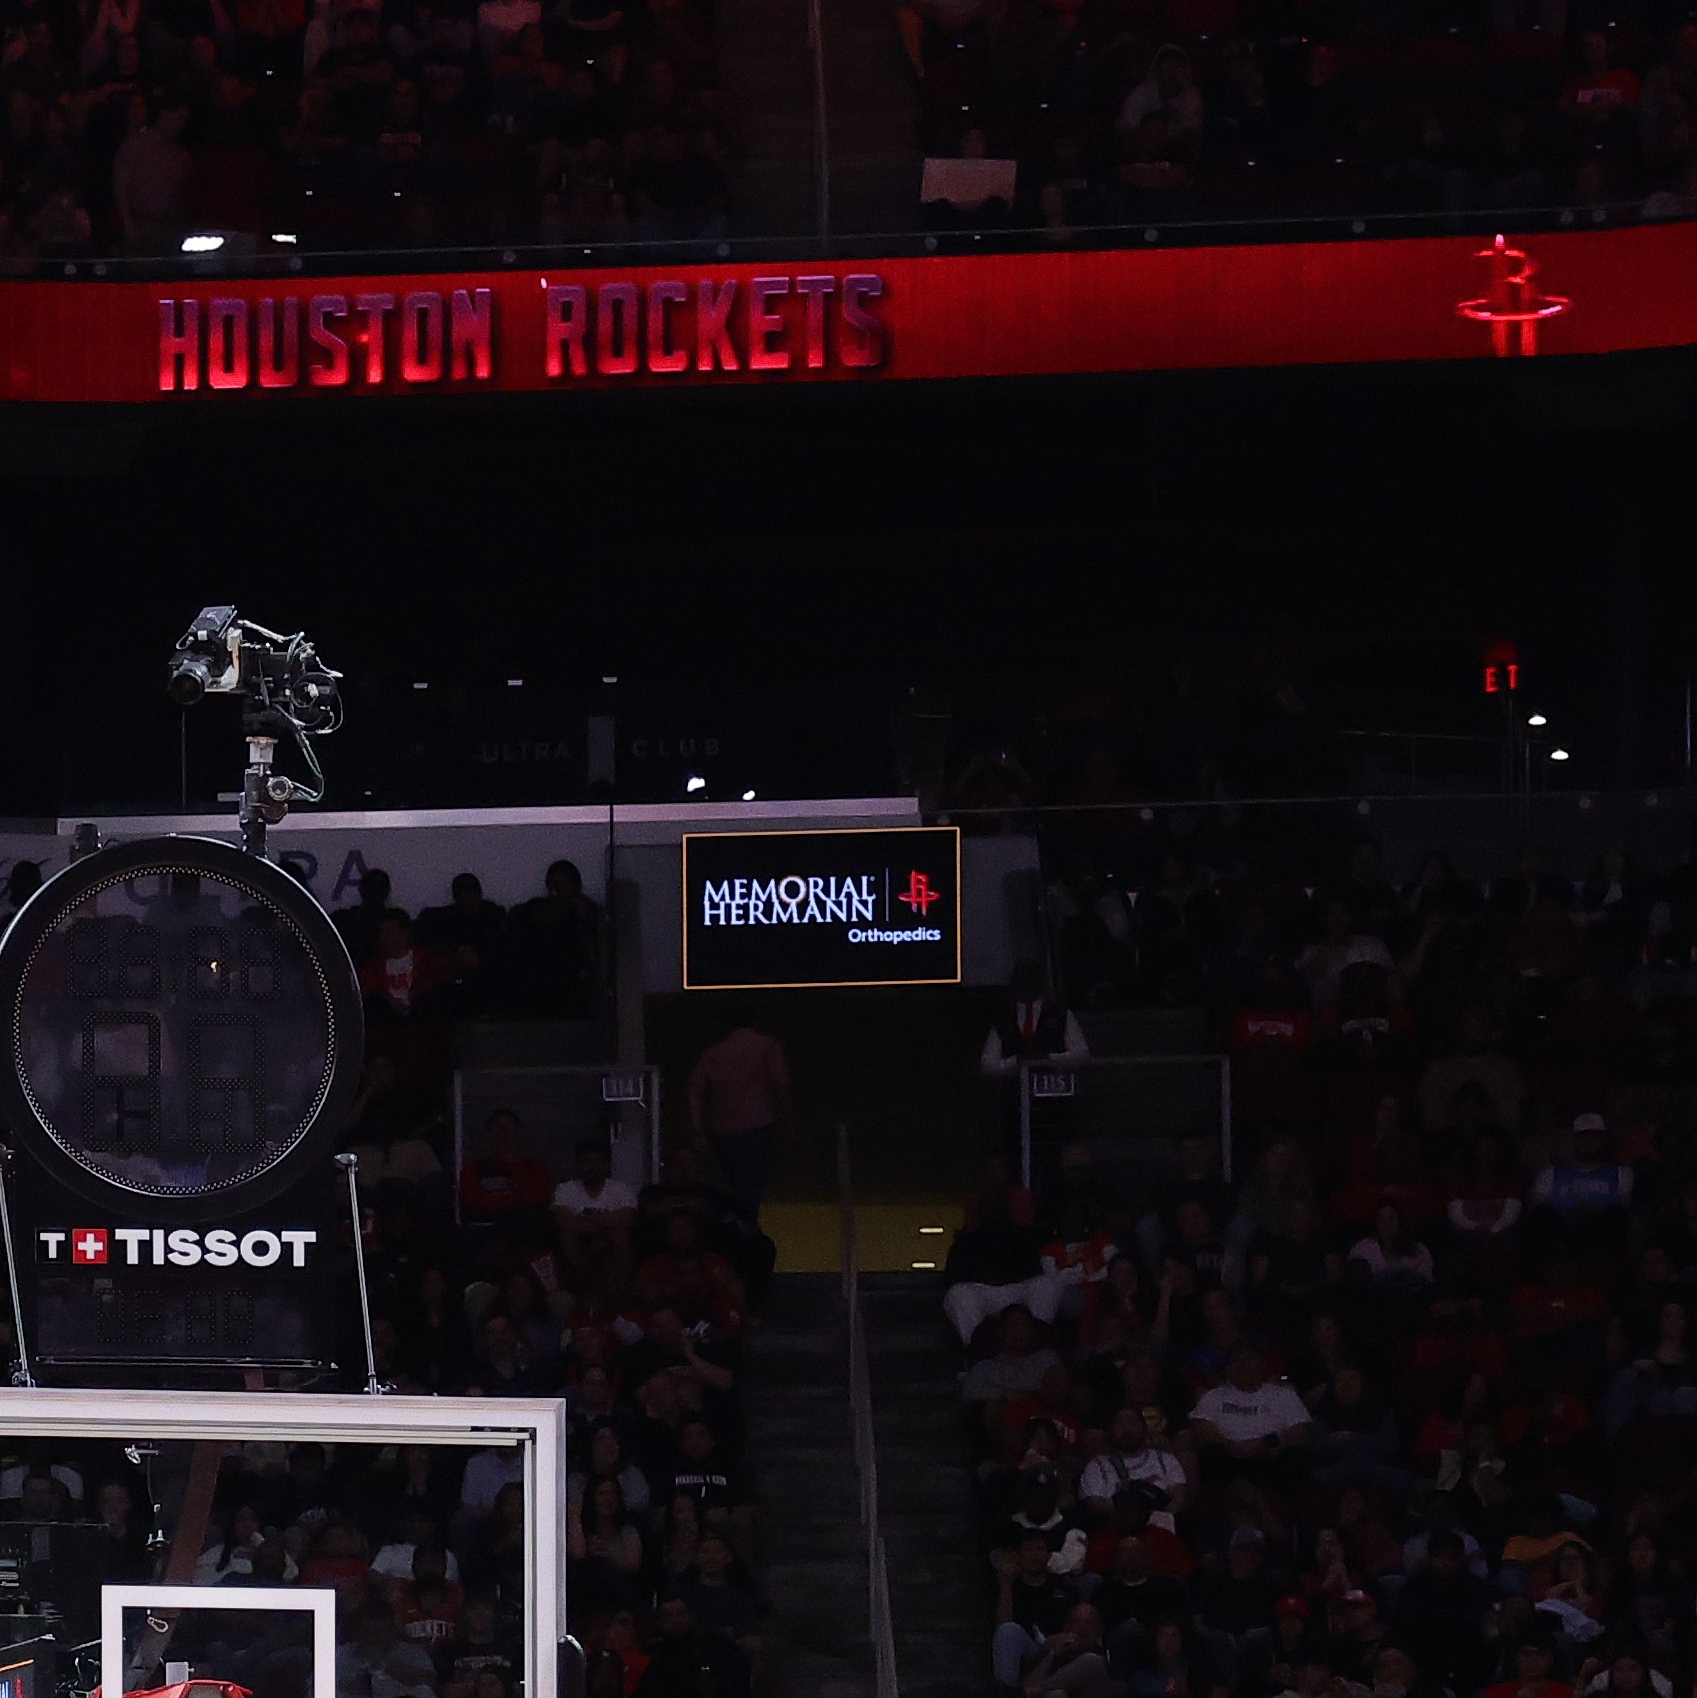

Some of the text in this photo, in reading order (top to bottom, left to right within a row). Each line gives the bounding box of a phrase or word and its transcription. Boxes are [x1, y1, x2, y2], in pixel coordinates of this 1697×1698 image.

[158, 274, 885, 392] HOUSTON ROCKETS
[704, 874, 876, 904] MEMORIAL
[703, 898, 874, 926] HERMANN
[848, 926, 942, 945] Orthopedics
[114, 1228, 317, 1268] TISSOT
